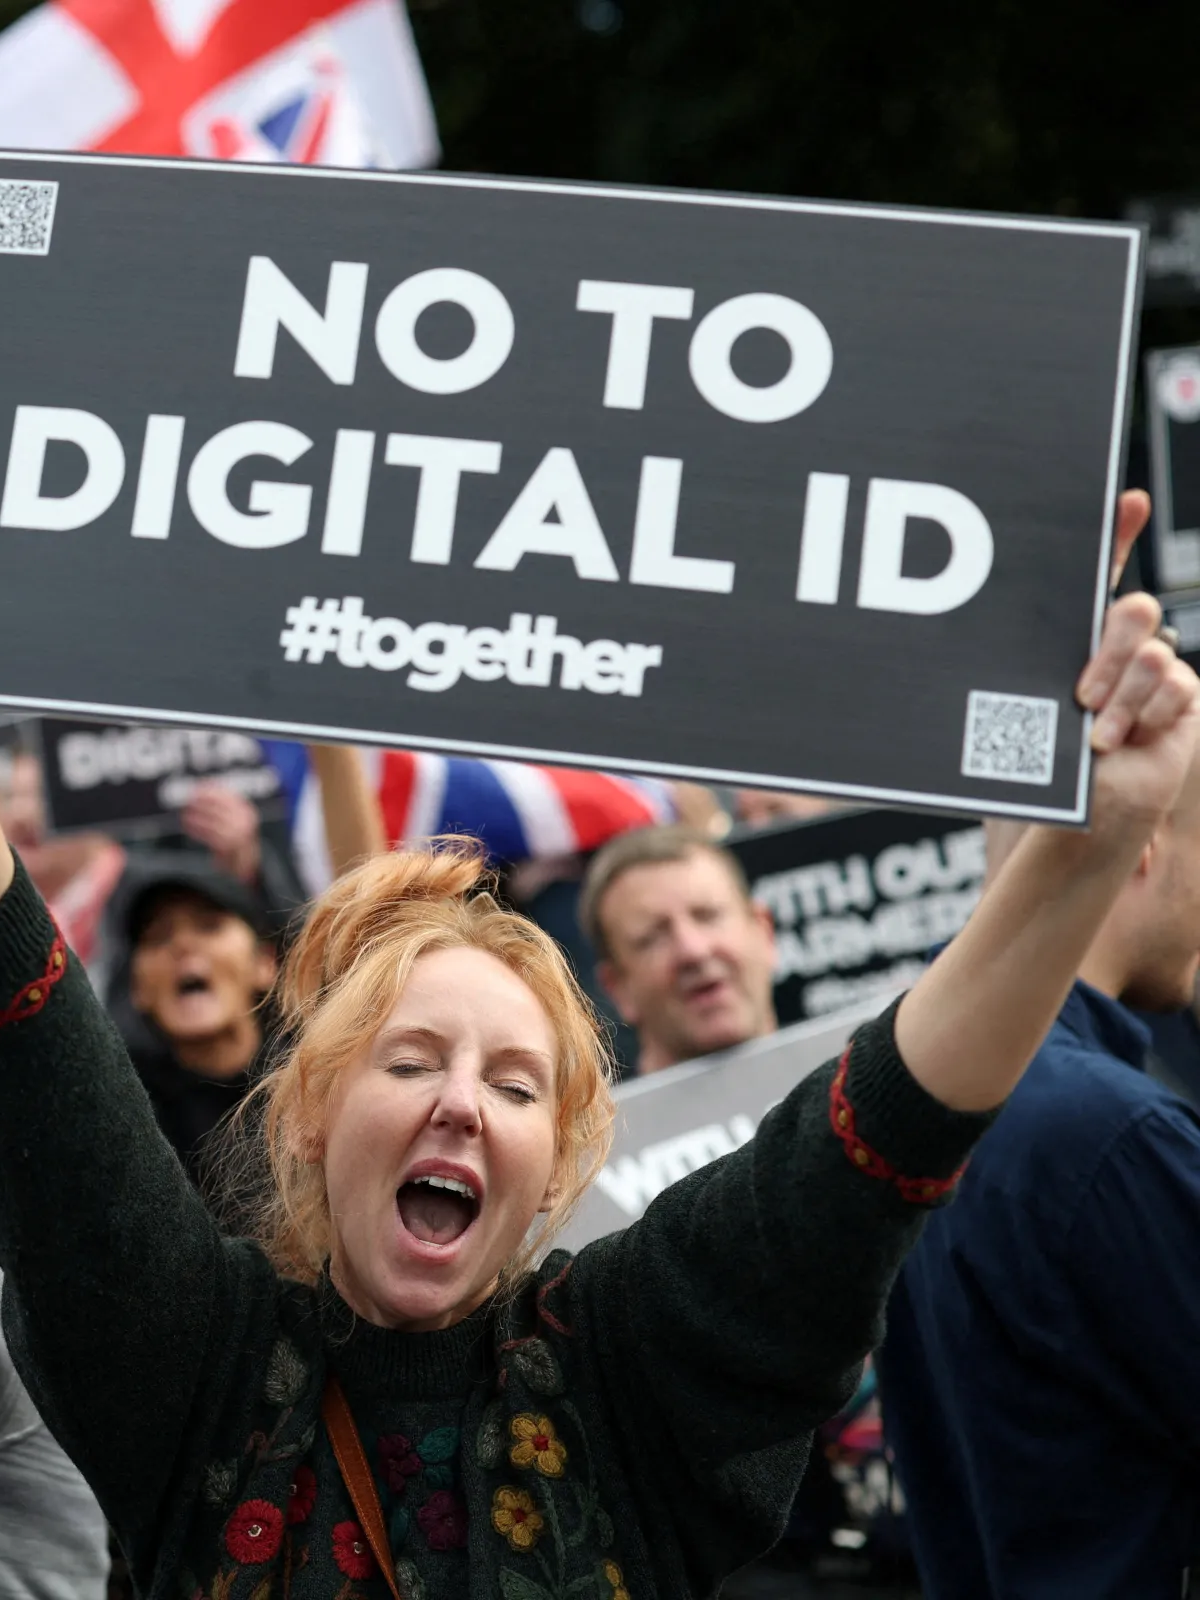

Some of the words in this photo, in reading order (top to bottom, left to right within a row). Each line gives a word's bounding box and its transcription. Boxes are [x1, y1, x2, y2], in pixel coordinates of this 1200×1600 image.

[234, 256, 514, 394] NO
[577, 280, 832, 422] TO
[0, 405, 734, 593] DIGITAL
[797, 472, 993, 614] ID
[279, 597, 663, 697] #together
